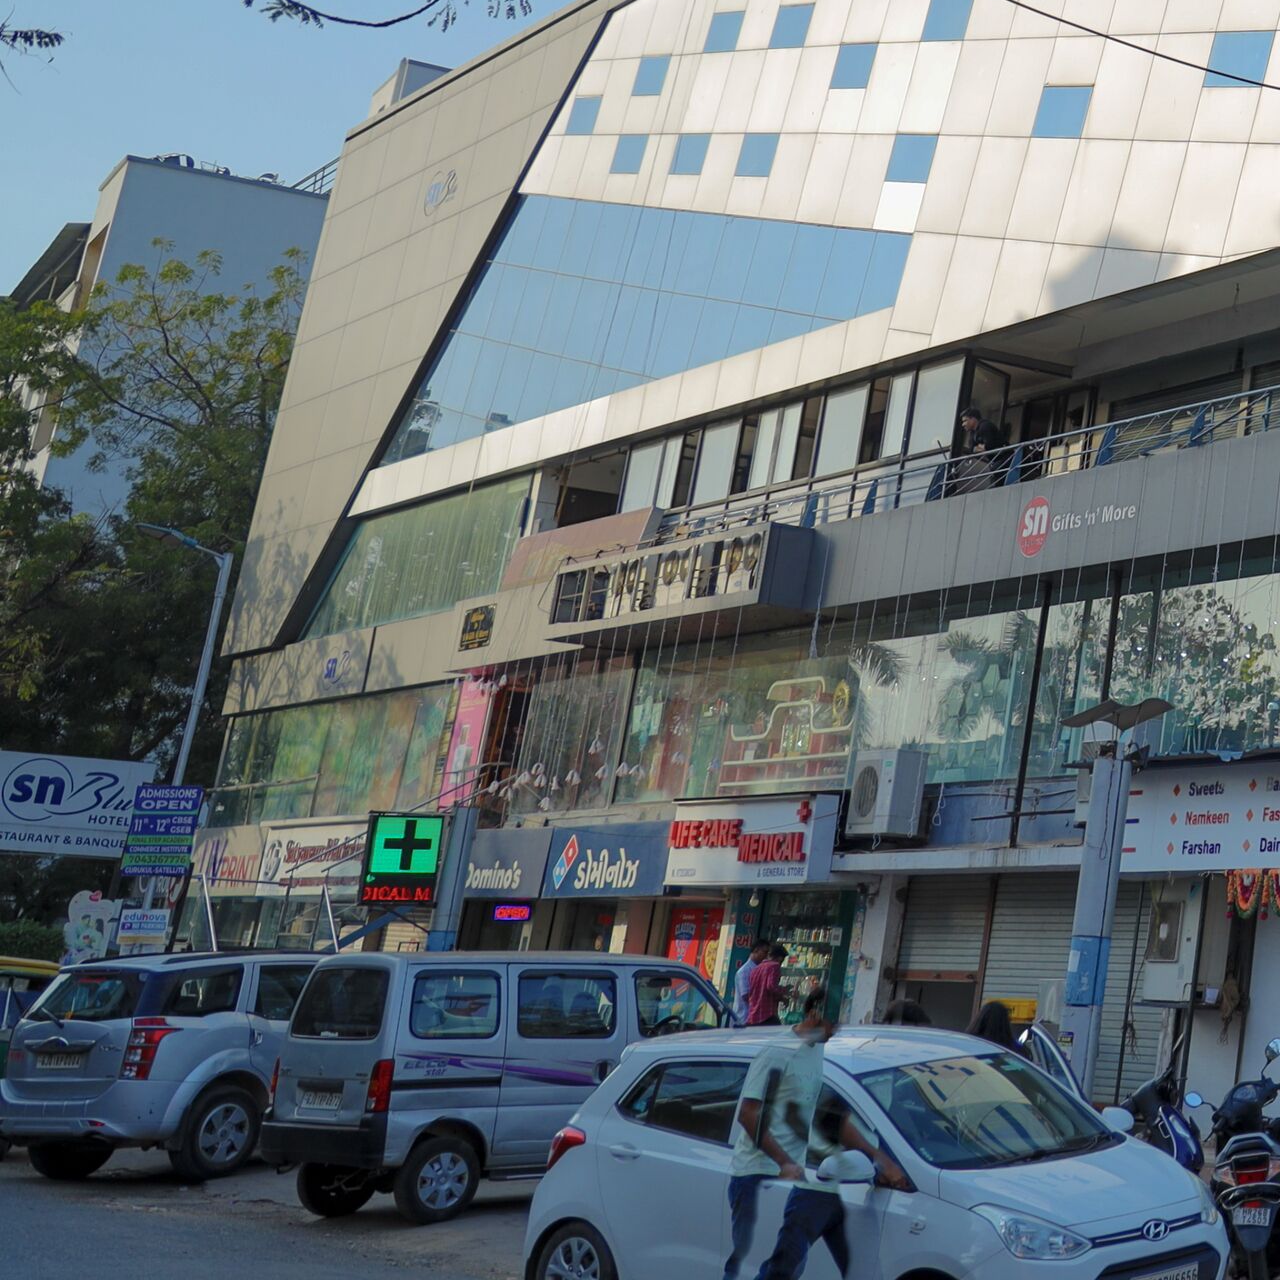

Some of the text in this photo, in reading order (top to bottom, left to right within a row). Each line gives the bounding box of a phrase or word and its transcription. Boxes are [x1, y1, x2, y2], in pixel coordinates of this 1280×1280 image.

[1022, 504, 1049, 537] sn
[1052, 512, 1081, 532] Gifts
[1102, 503, 1136, 524] More
[9, 772, 133, 815] sn Blu
[139, 788, 197, 799] ADMISSIONS
[1188, 782, 1224, 797] Sweets
[142, 800, 193, 810] OPEN
[88, 815, 130, 827] HOTEL
[1185, 810, 1229, 826] Namkeen
[170, 826, 192, 834] GSEB
[671, 819, 743, 848] LIFE CARE
[63, 836, 71, 844] &
[1182, 840, 1221, 856] Farshan
[574, 848, 640, 889] ડોમીનોઝ
[762, 867, 786, 877] GENERAL
[788, 867, 804, 876] STORE
[123, 912, 167, 922] edunova
